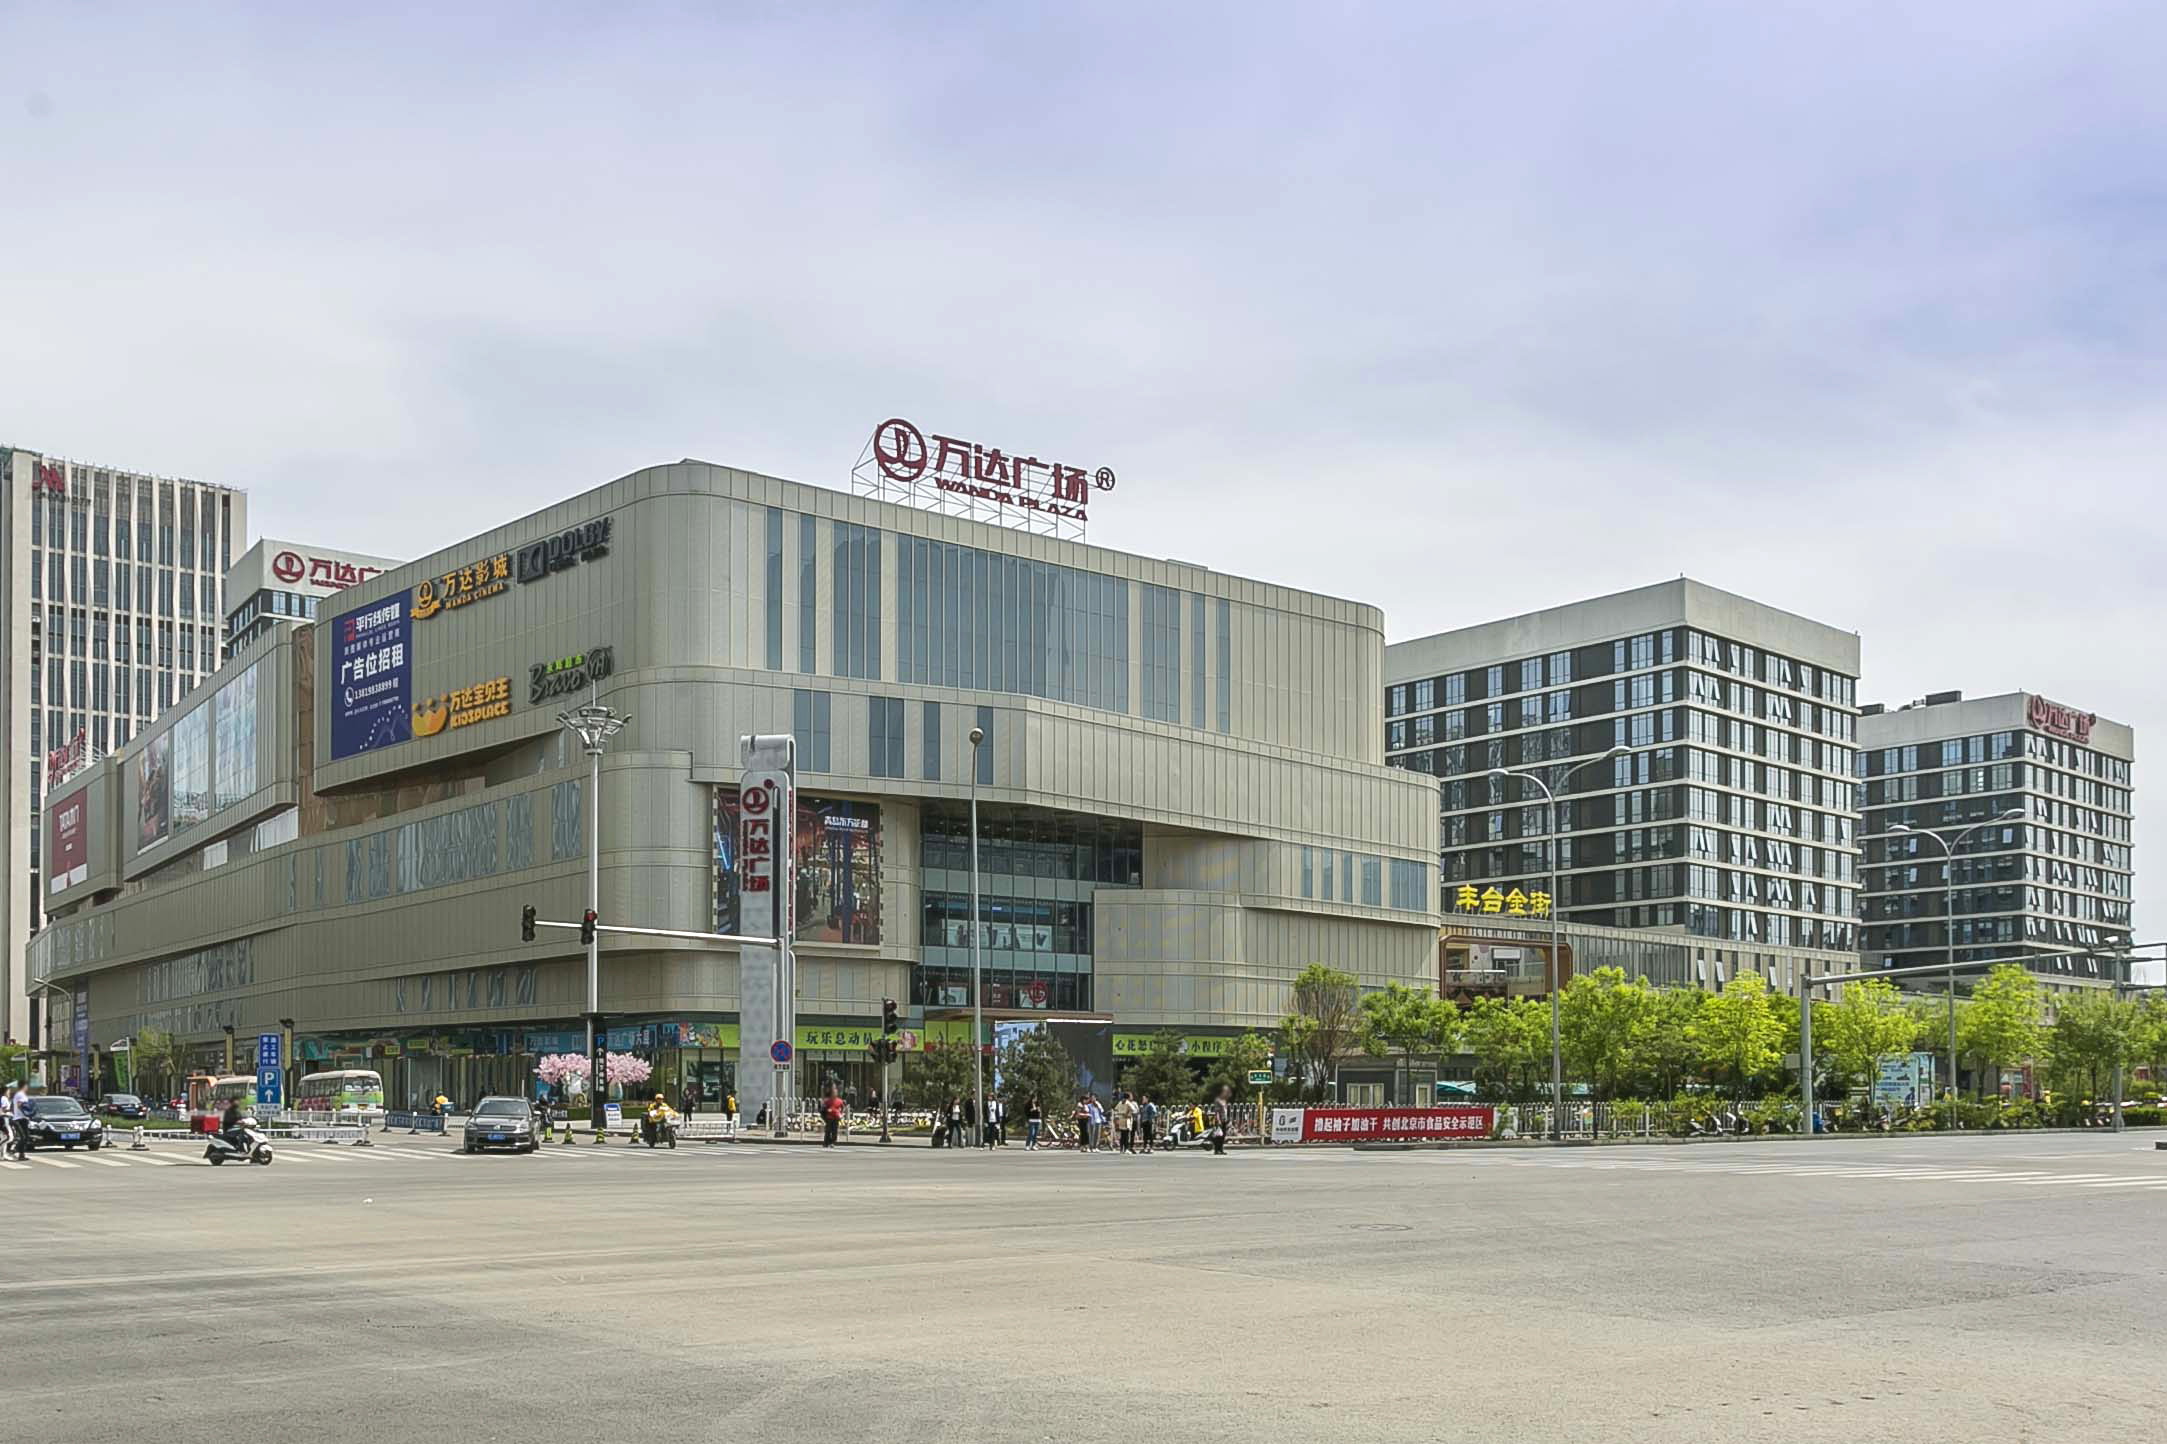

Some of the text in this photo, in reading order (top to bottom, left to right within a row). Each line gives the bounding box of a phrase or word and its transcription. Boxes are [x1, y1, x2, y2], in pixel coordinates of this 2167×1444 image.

[931, 434, 1088, 505] 万达广场
[935, 477, 1089, 521] WANDA PLAZA
[550, 516, 613, 559] DOLBY
[442, 553, 509, 598] 万达影城
[444, 581, 505, 610] WANDA CINEMA
[341, 643, 404, 685] 广告位招租
[528, 663, 585, 704] Bravo
[450, 677, 510, 712] 万达宝贝王
[450, 701, 510, 729] KIDSPLACE
[749, 819, 770, 891] 万达广场
[1456, 884, 1552, 919] 丰台金街
[264, 1072, 275, 1085] P
[1314, 1115, 1484, 1132] 撸起袖子加油干 共创北京市食品安全示范区
